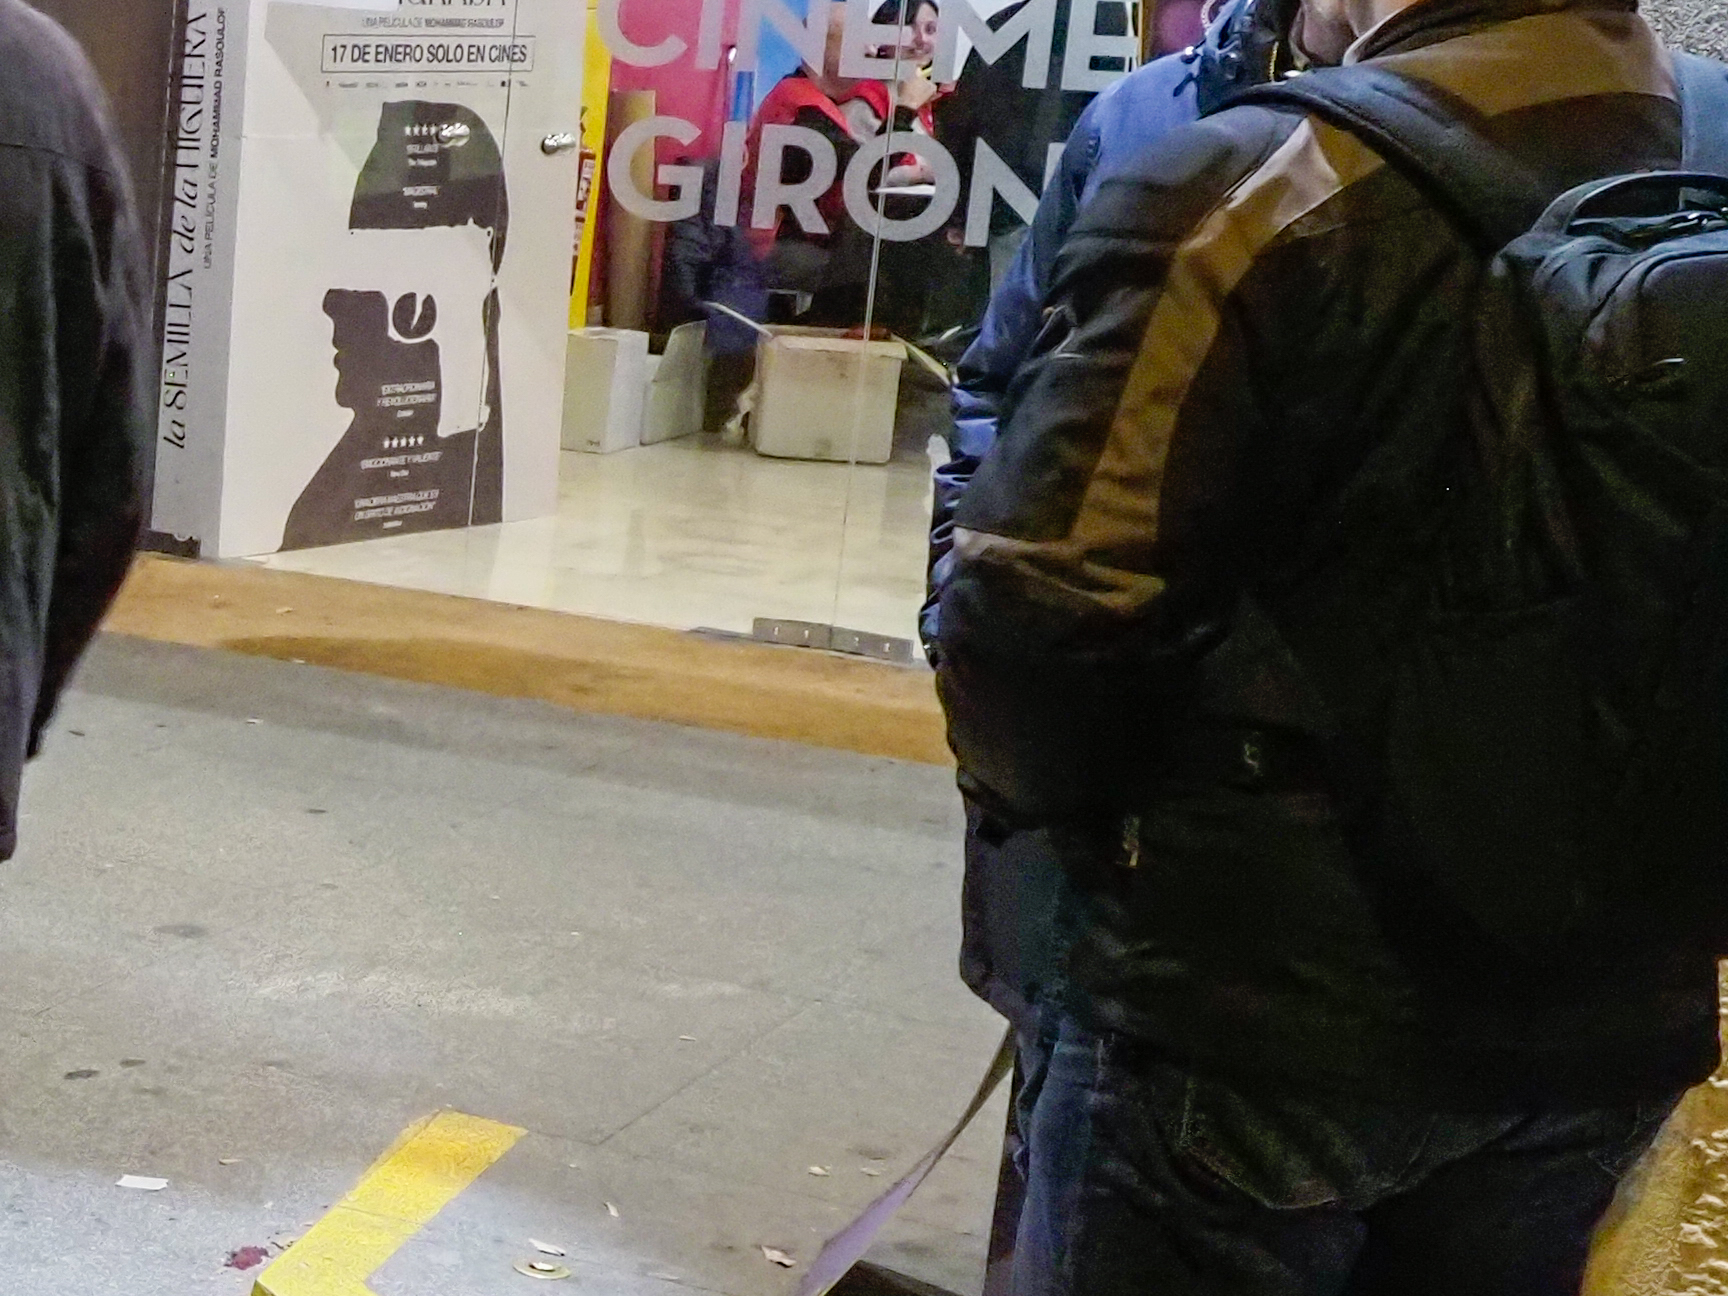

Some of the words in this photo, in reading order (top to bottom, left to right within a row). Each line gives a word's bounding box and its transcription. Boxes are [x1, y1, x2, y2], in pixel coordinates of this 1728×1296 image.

[331, 45, 348, 63] 17
[351, 44, 372, 63] DE
[374, 44, 424, 63] ENERO
[426, 43, 465, 63] SOLO
[467, 44, 487, 63] EN
[608, 115, 1066, 248] GIRON
[164, 269, 194, 411] SEMILLA
